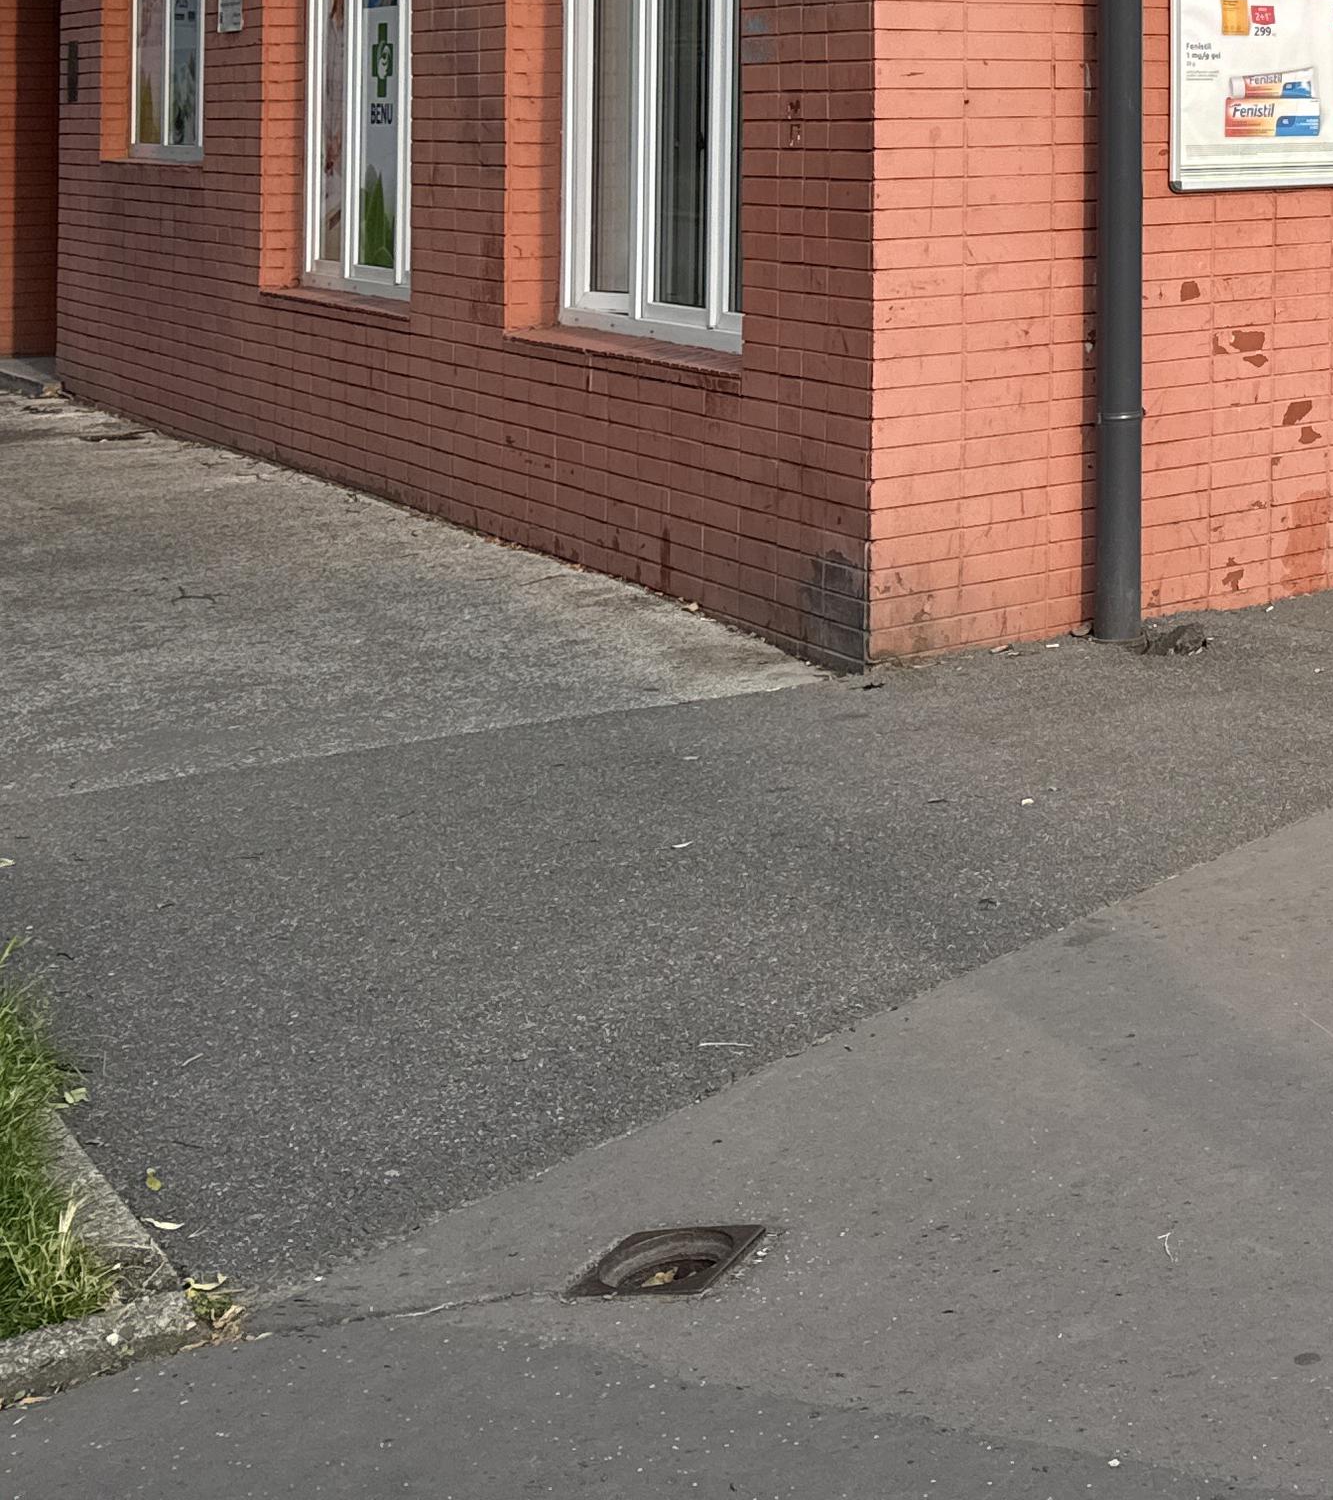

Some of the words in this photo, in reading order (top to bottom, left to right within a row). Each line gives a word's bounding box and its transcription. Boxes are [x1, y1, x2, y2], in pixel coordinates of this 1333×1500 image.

[1254, 26, 1272, 37] 299
[1186, 42, 1212, 50] Fenistil
[1249, 74, 1283, 85] Fenistil
[370, 103, 393, 125] BENU
[1232, 103, 1275, 118] Fenistil
